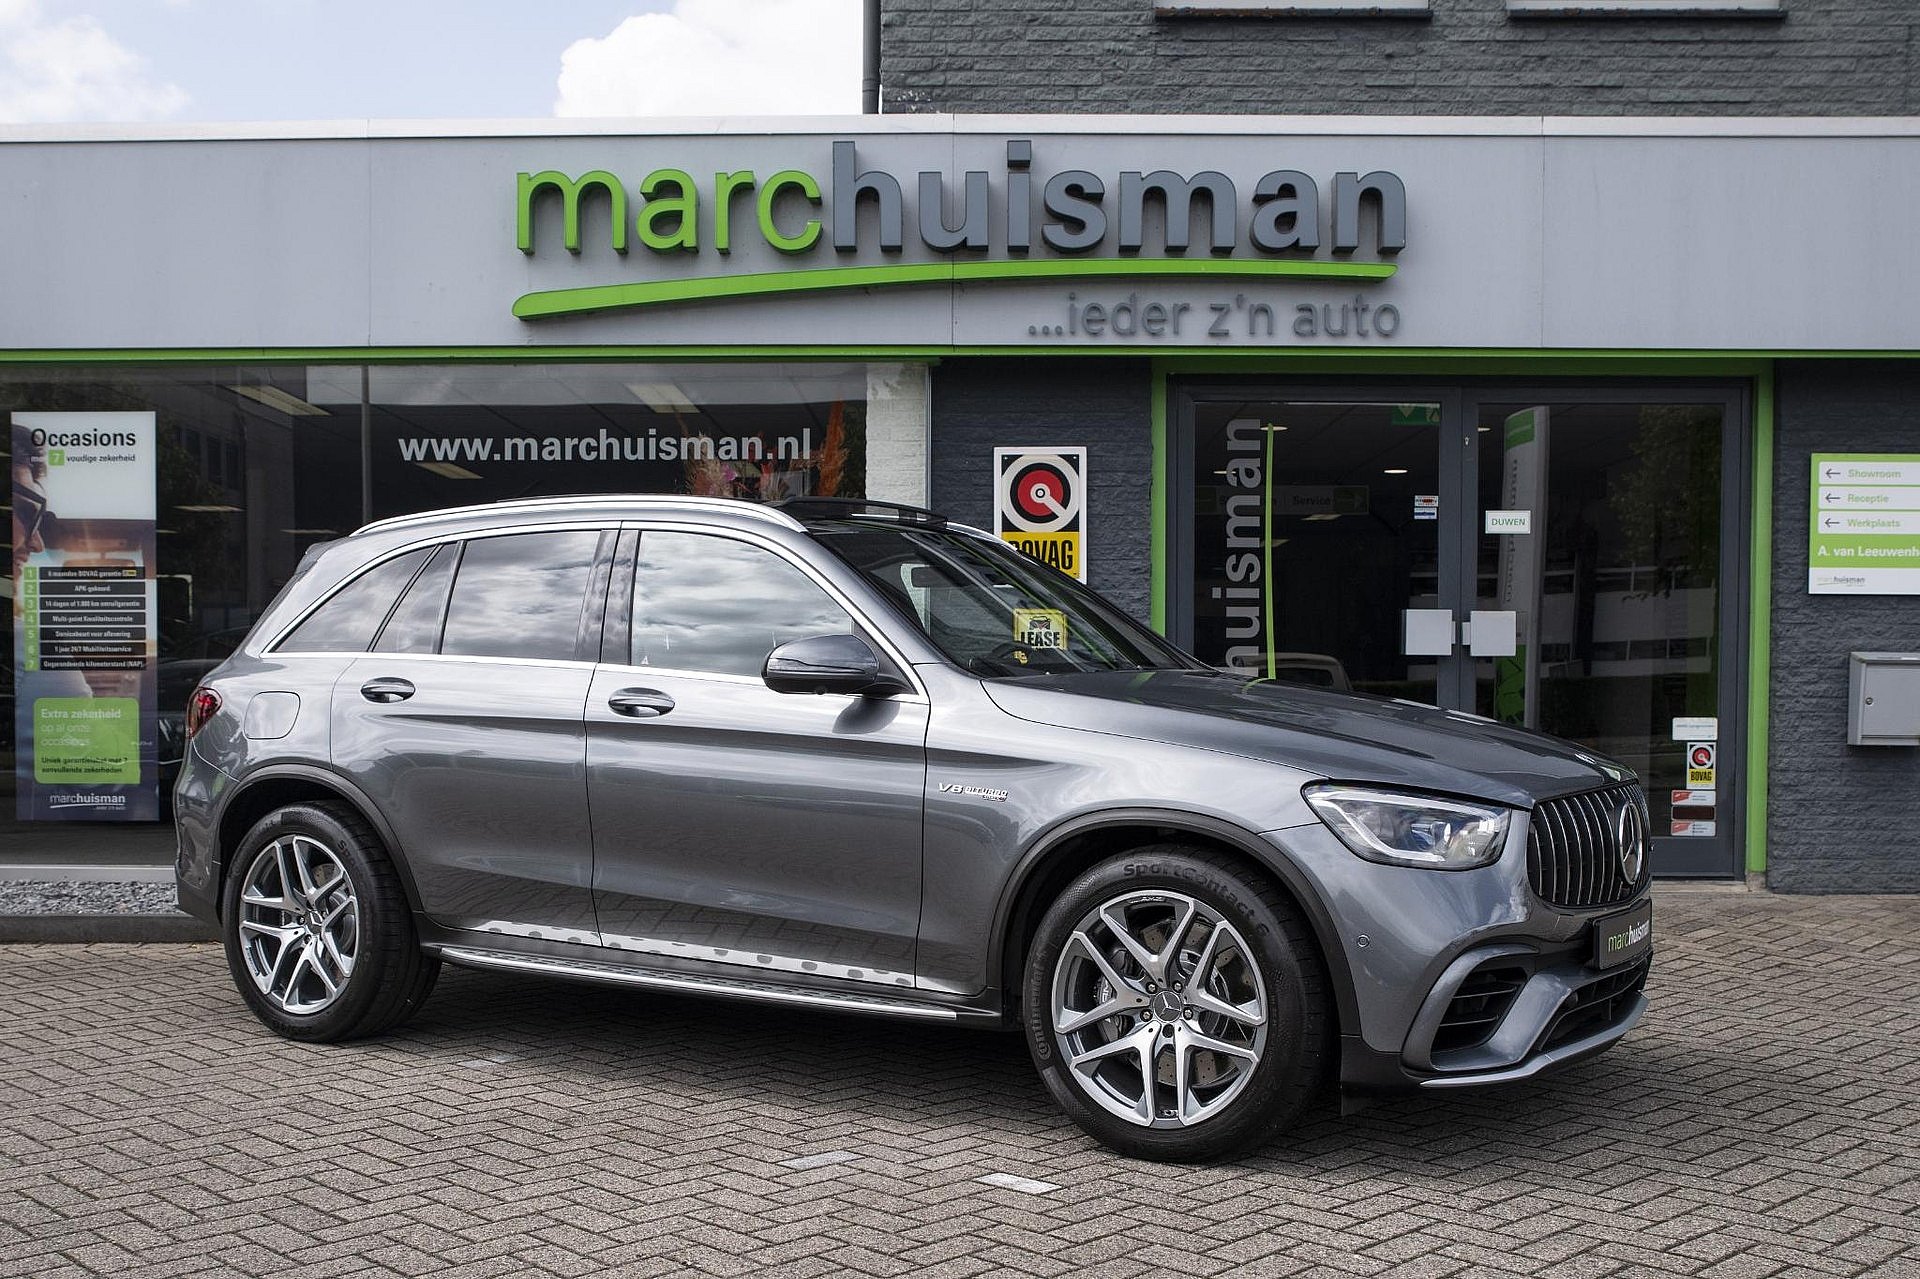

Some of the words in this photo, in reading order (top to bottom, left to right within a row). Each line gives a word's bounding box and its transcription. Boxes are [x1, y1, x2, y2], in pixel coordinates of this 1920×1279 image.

[516, 140, 1407, 256] marchuisman
[1029, 293, 1191, 338] ...ieder
[1209, 293, 1274, 338] z'n
[1293, 293, 1401, 338] auto
[31, 428, 136, 447] Occasions
[398, 428, 812, 461] www.marchuisman.nl
[67, 454, 97, 463] voudige
[99, 453, 136, 462] zekerheid
[1848, 468, 1902, 479] Showroom
[1848, 493, 1890, 504] Receptie
[1491, 518, 1525, 526] DUWEN
[1848, 518, 1901, 530] Werkplaats
[1818, 545, 1830, 557] A.
[1834, 547, 1854, 557] van
[41, 709, 68, 718] Extra
[71, 708, 121, 718] zekerheid
[1690, 771, 1712, 781] BOVAG
[939, 783, 963, 793] V8
[965, 786, 1009, 797] BITURBO
[49, 793, 126, 804] marchuisman
